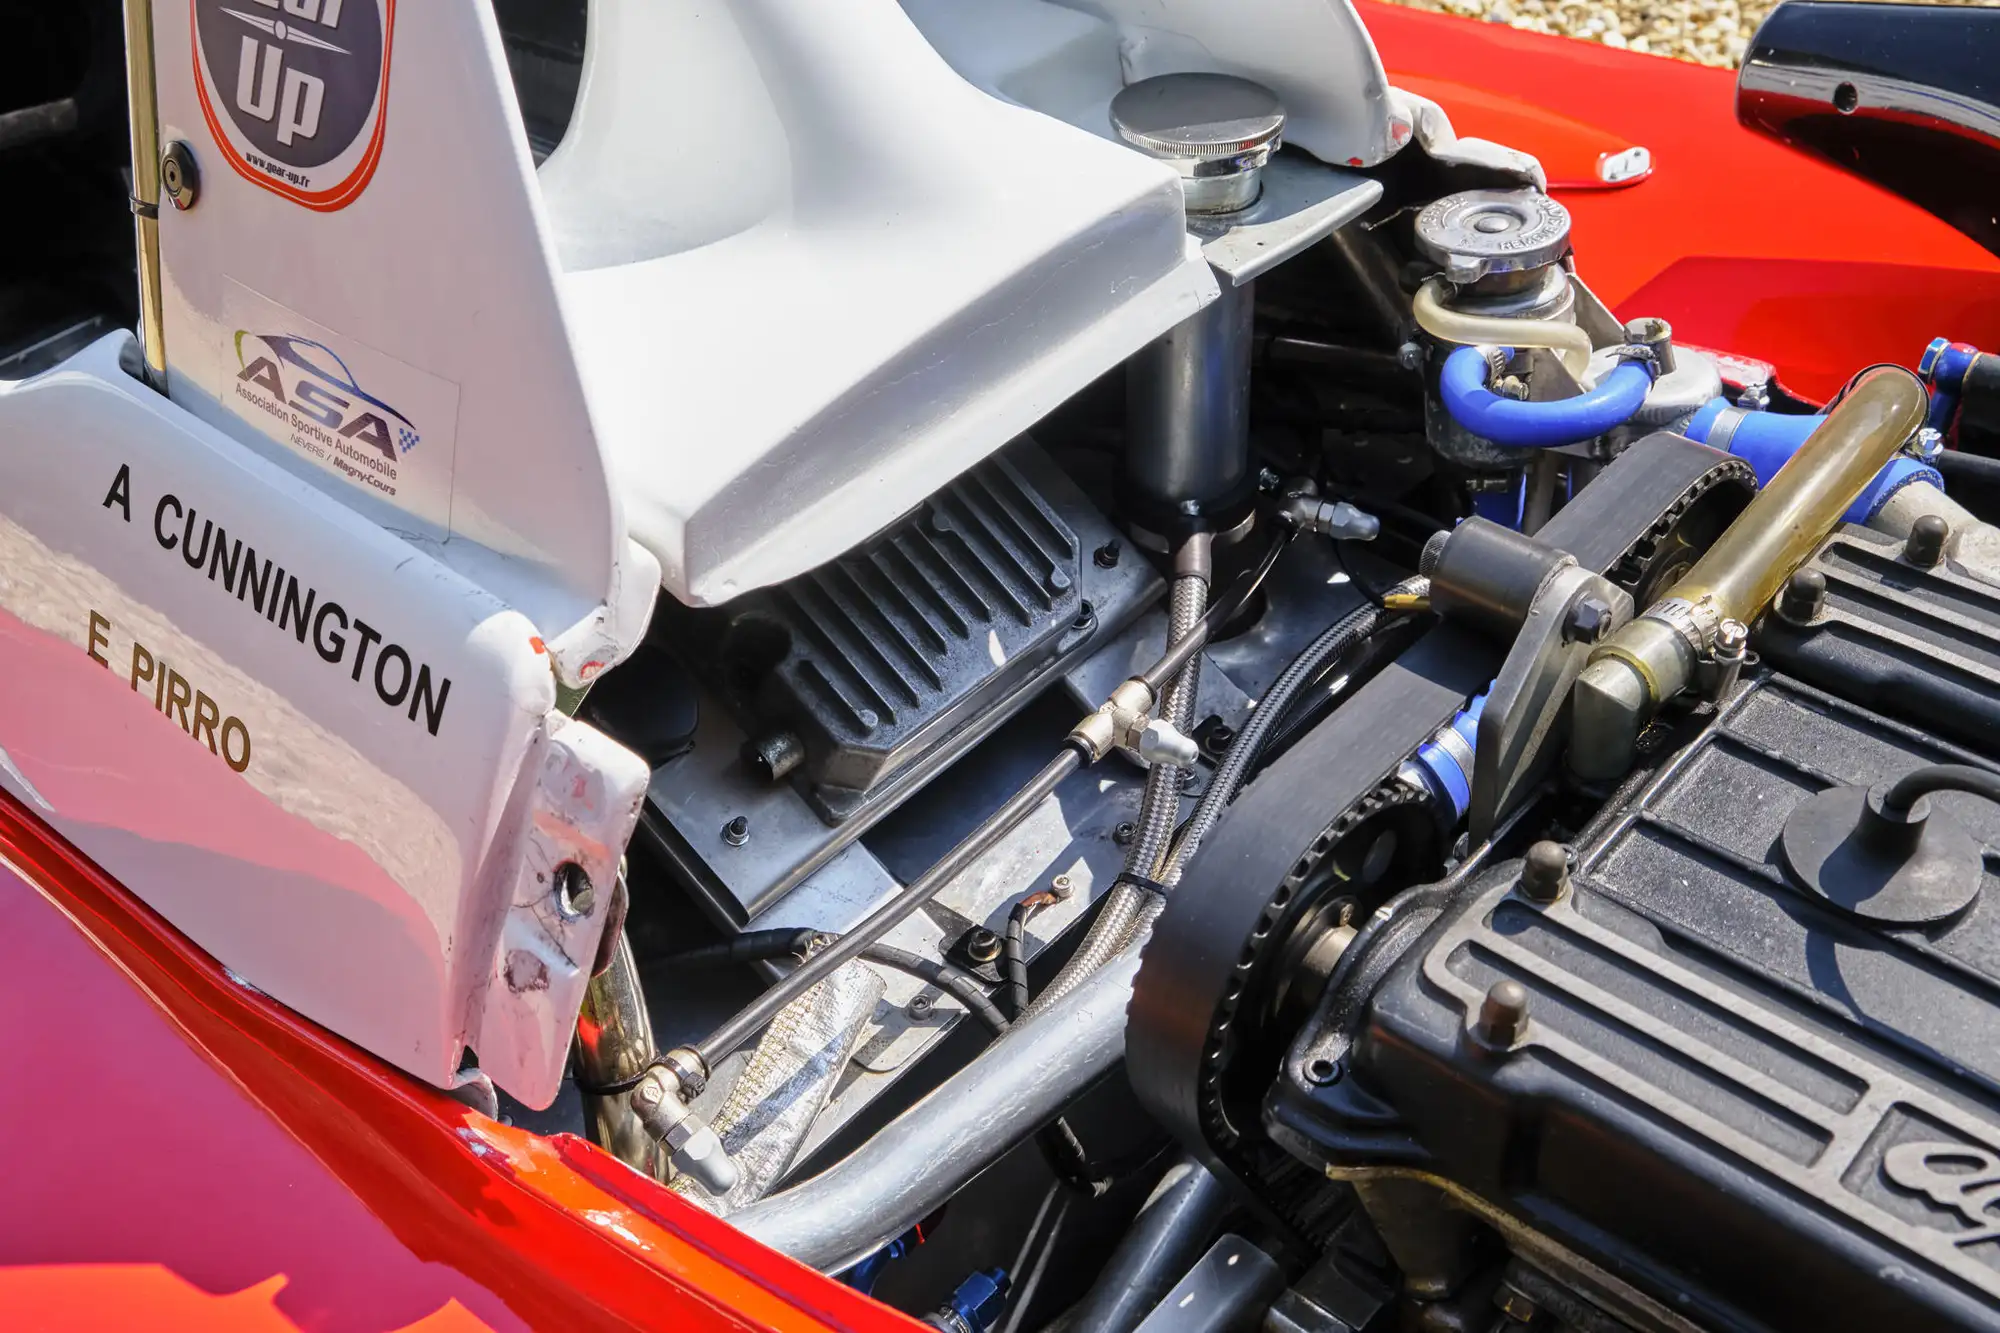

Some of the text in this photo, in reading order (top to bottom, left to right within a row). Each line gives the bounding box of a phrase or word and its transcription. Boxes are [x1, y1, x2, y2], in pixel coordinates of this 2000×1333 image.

[236, 35, 325, 147] Up
[246, 152, 311, 188] www.gear-up.fr
[235, 382, 397, 480] Association Sportive Automobile
[237, 356, 398, 463] ASA
[290, 433, 325, 459] NEVERS
[333, 456, 396, 496] Magny-Cours
[102, 463, 452, 736] A CUNNINGTON
[87, 609, 251, 773] E PIRRO
